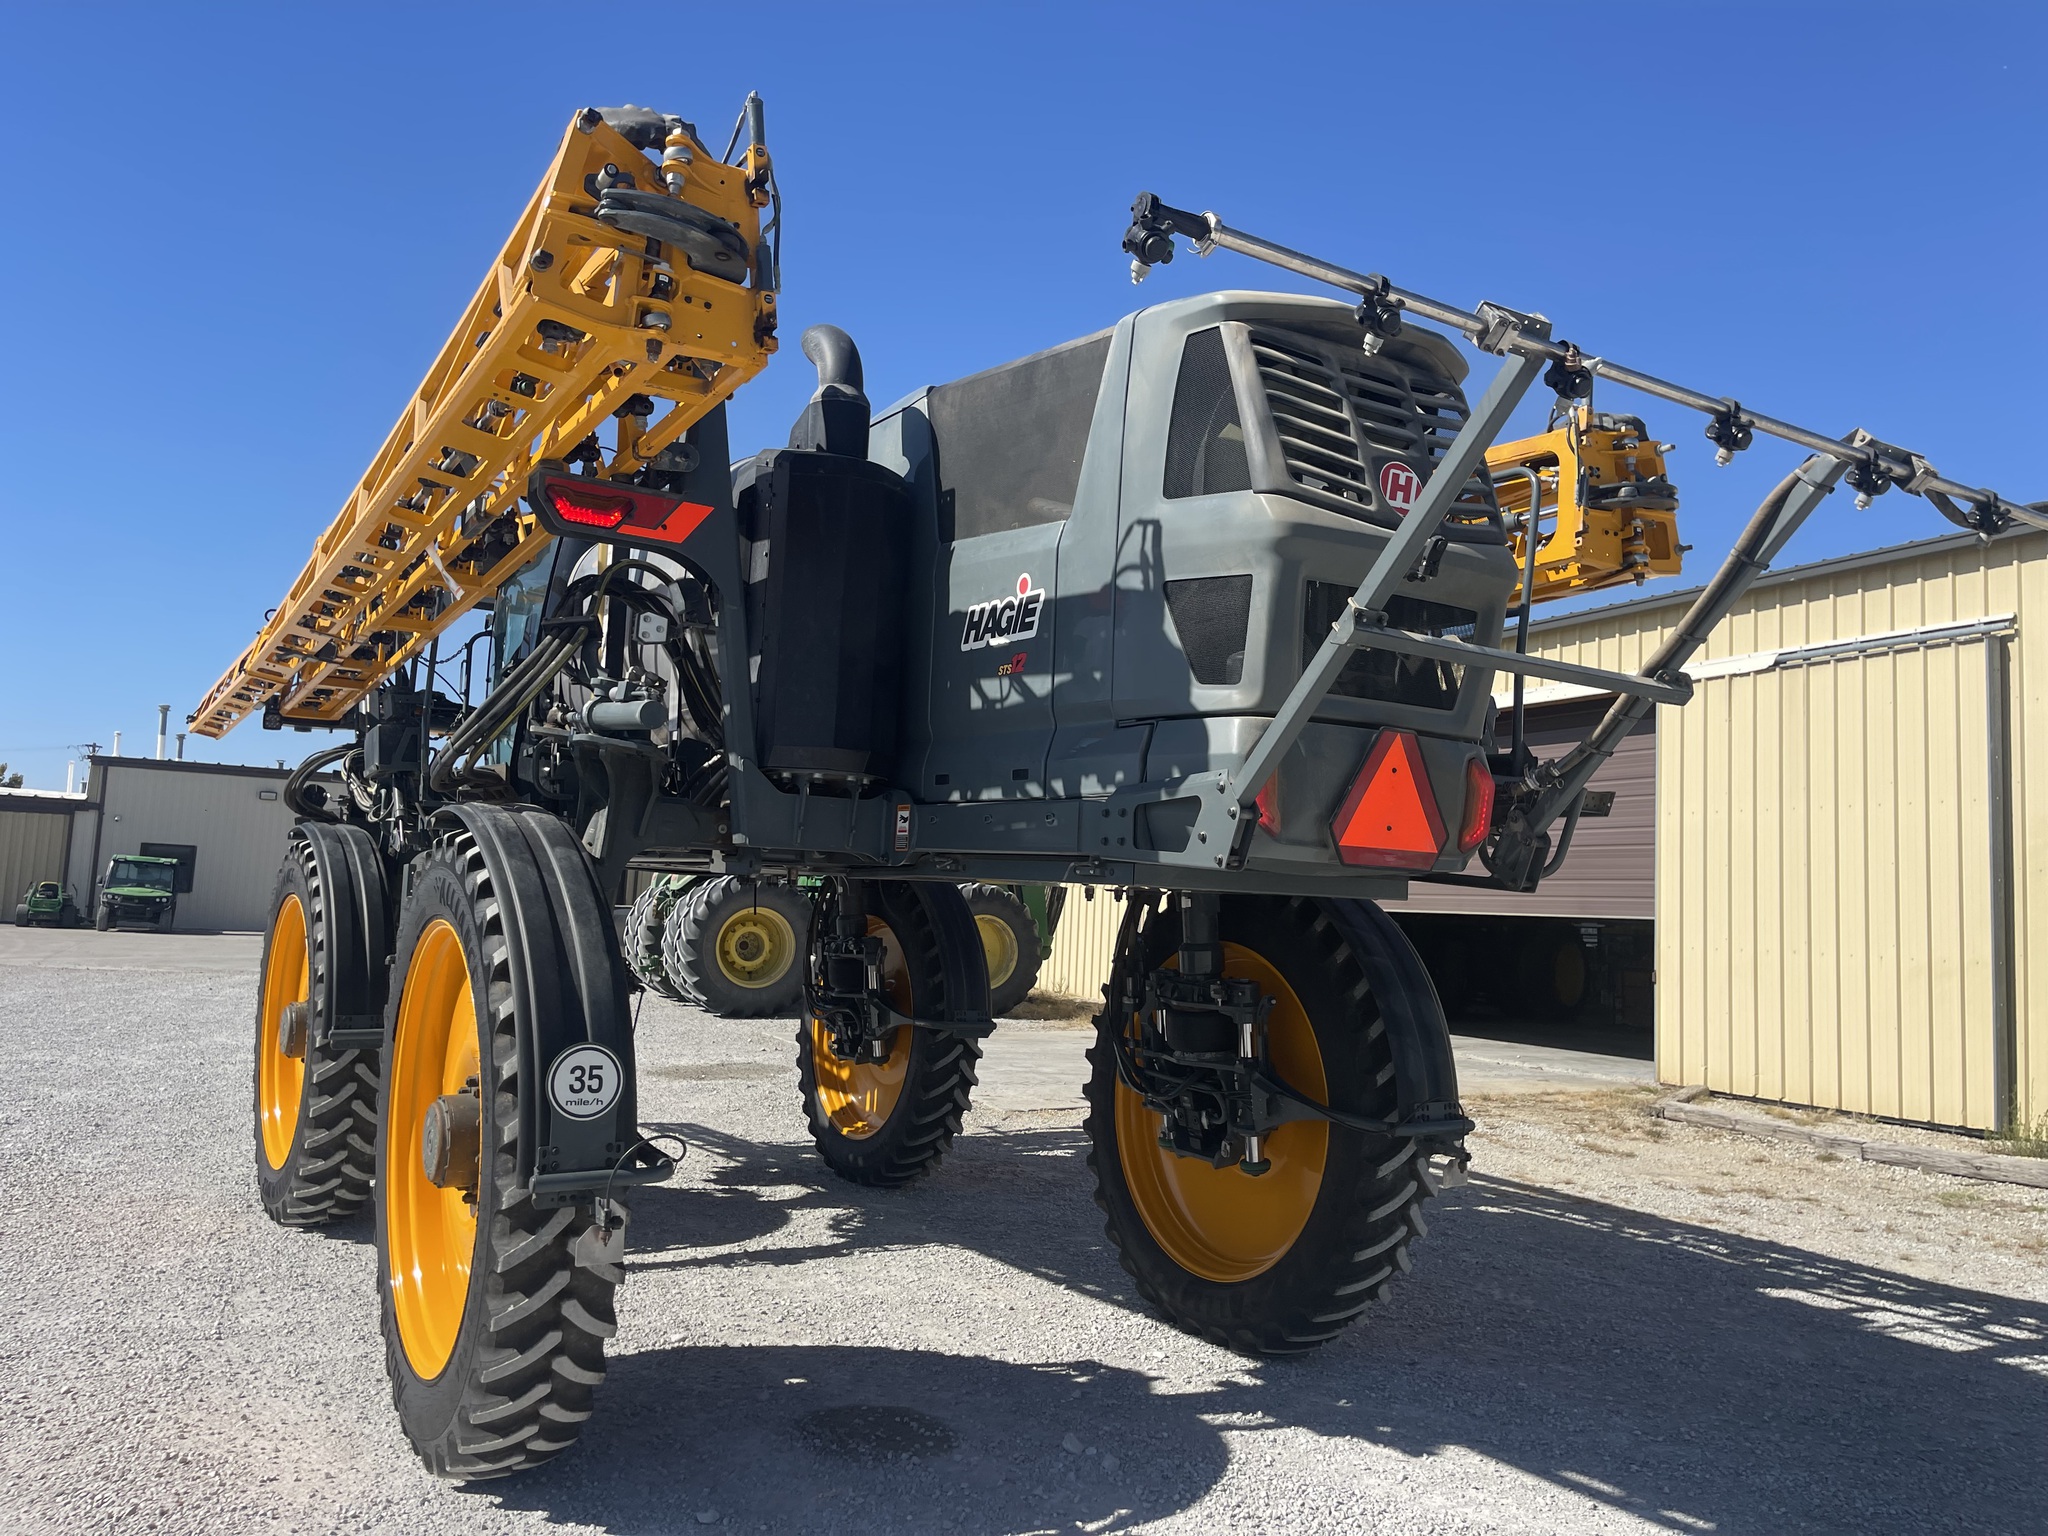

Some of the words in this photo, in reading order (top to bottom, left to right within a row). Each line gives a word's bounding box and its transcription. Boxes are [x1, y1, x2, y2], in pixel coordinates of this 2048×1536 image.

[1389, 472, 1413, 504] H
[962, 575, 1042, 646] HAGIE
[569, 1065, 604, 1094] 35
[565, 1098, 604, 1106] mile/h
